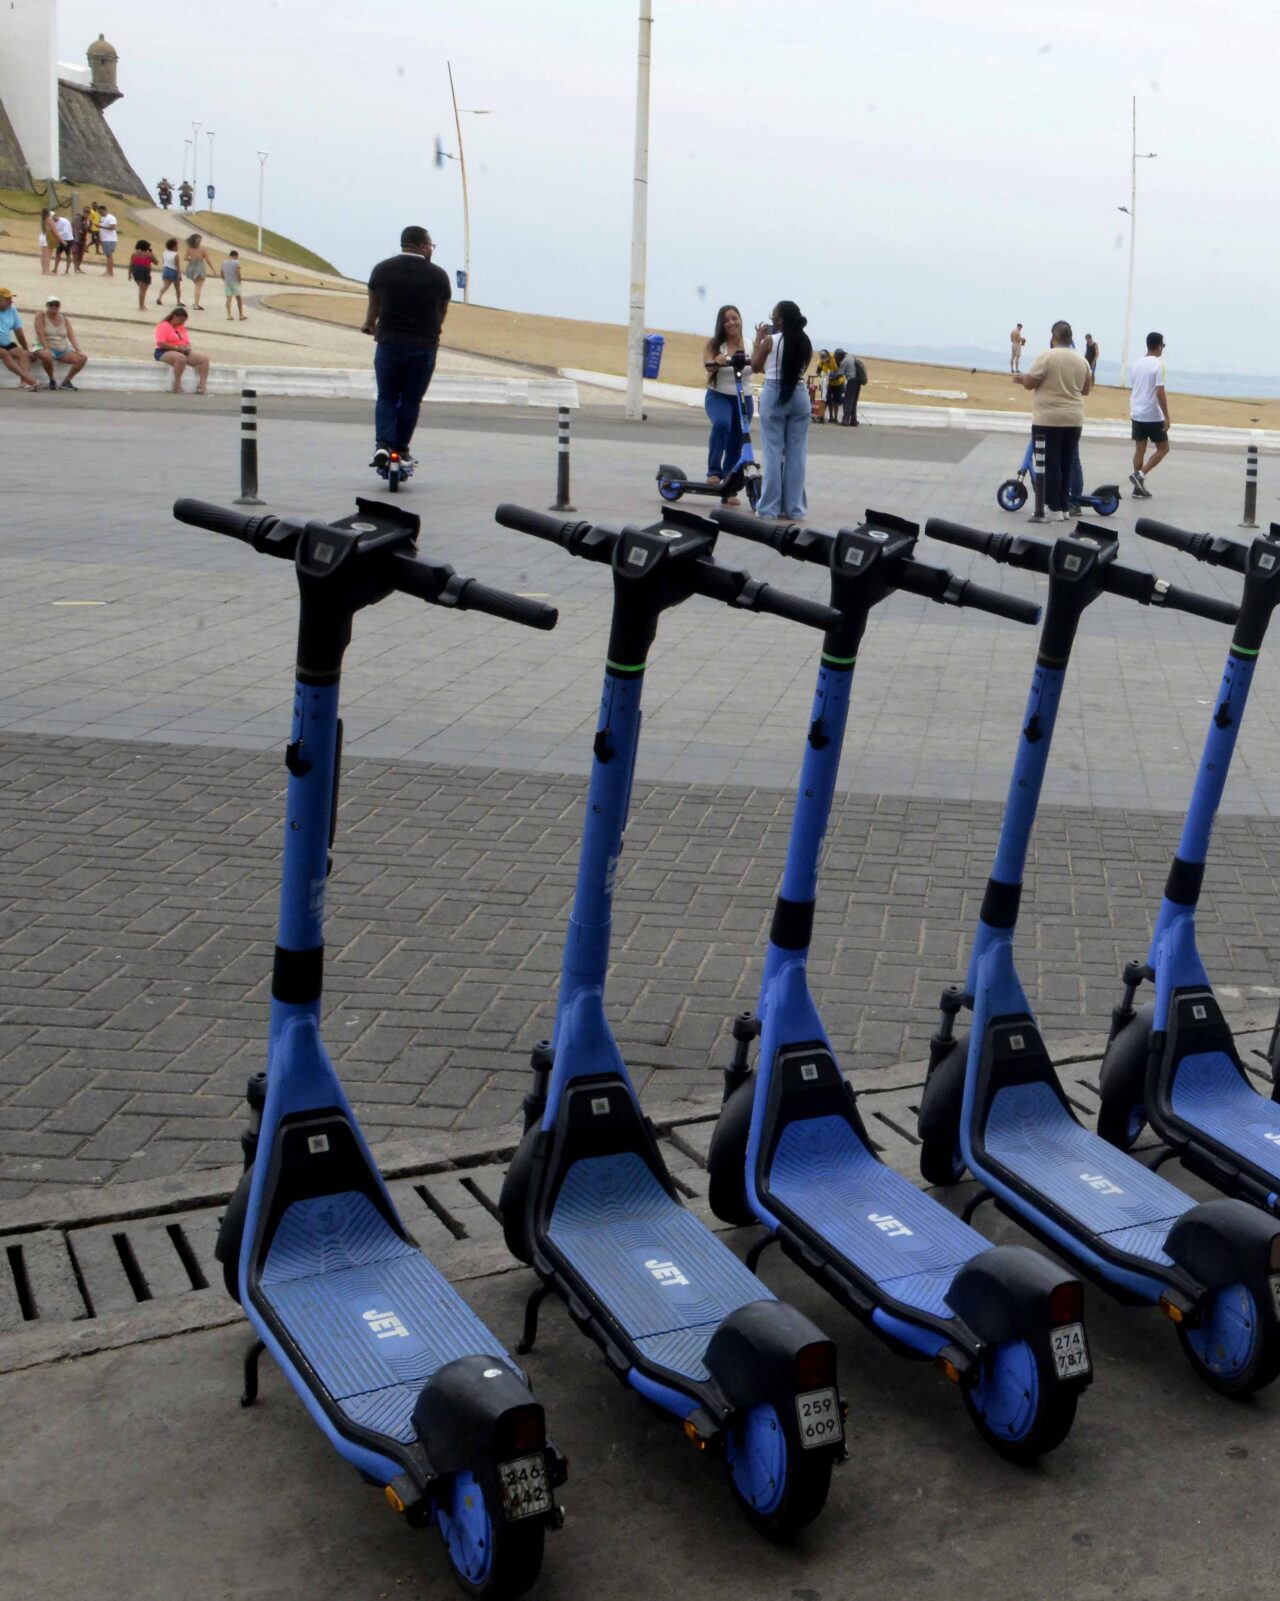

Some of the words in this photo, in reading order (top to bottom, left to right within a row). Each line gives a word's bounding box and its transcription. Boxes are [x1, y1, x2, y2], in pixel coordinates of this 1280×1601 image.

[1079, 1172, 1124, 1195] JET
[867, 1213, 914, 1237] JET
[644, 1259, 690, 1286] JET
[362, 1309, 410, 1339] JET
[1058, 1351, 1083, 1368] 787
[802, 1398, 832, 1417] 259
[806, 1419, 835, 1437] 609
[507, 1465, 540, 1486] 246
